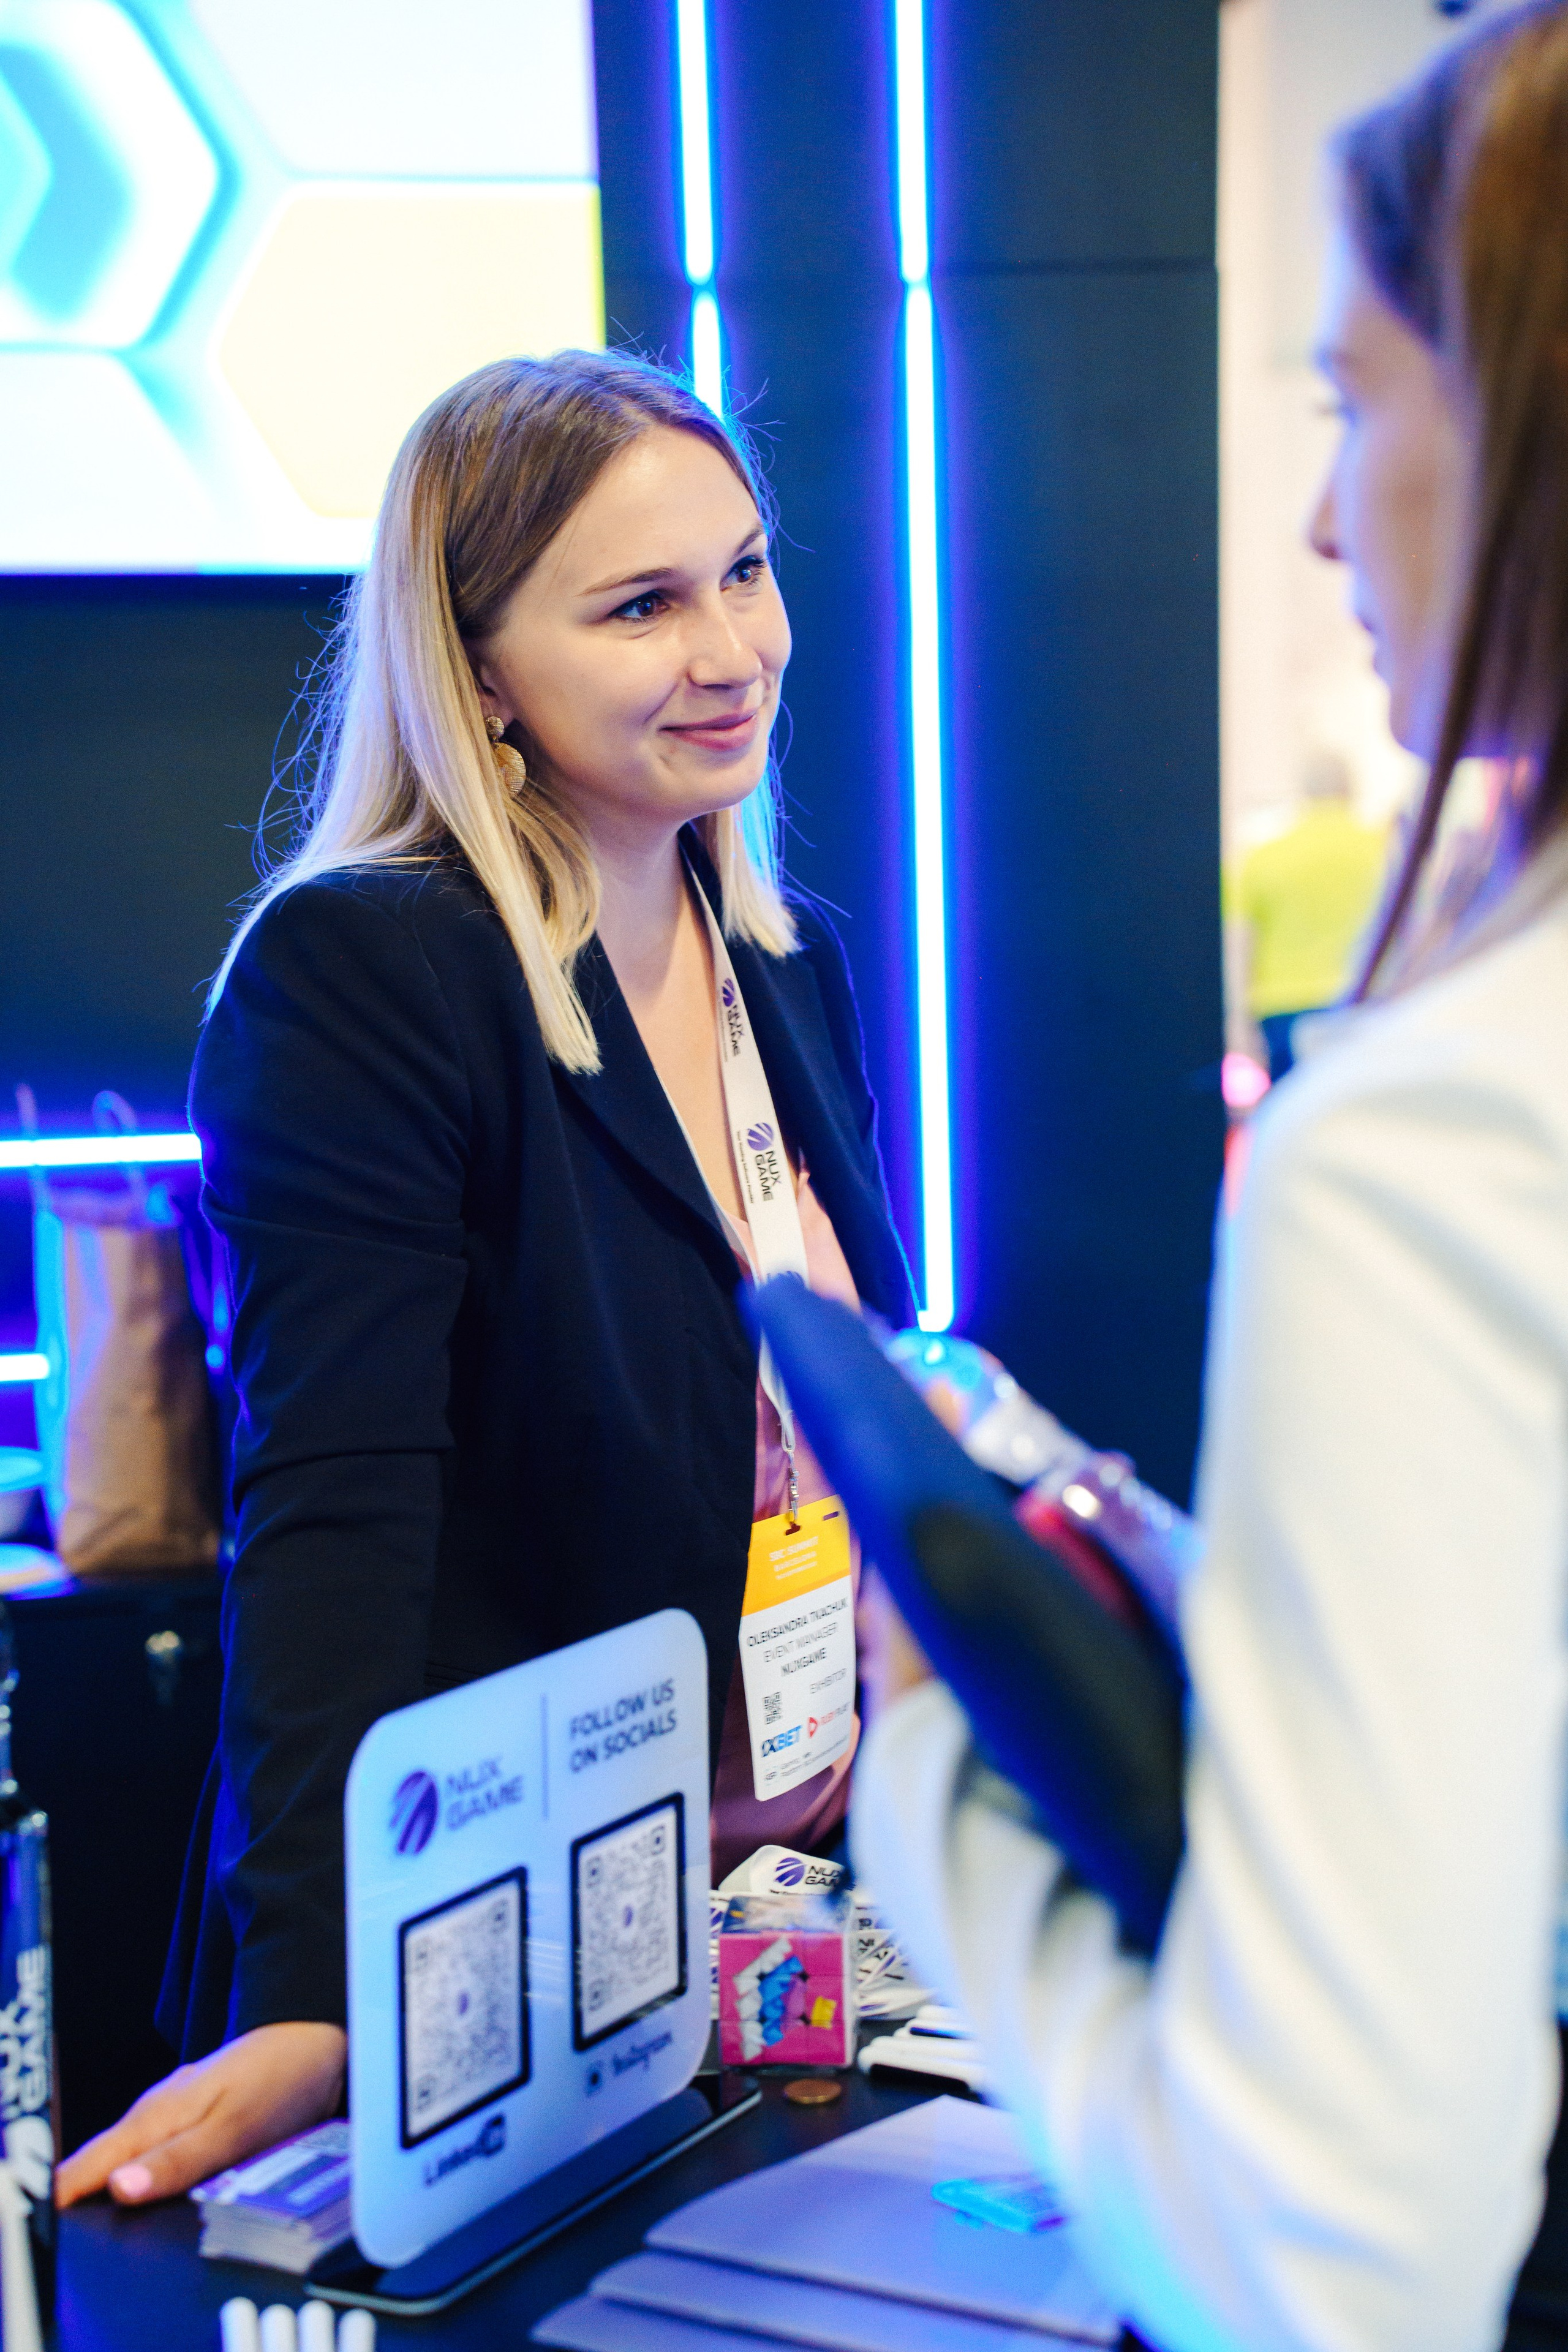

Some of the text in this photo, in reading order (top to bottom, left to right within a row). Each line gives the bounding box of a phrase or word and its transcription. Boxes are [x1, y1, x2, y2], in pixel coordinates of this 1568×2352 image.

[755, 1154, 774, 1201] GAME
[766, 1150, 782, 1186] NUX
[746, 1615, 809, 1647] OLEKSANDRA
[763, 1622, 839, 1663] EVENT MANAGER
[781, 1647, 827, 1676] NUXGAME
[570, 1678, 674, 1740] FOLLOW US
[570, 1708, 678, 1774] ON SOCIALS
[445, 1754, 503, 1795] NUX
[445, 1773, 524, 1831] GAME
